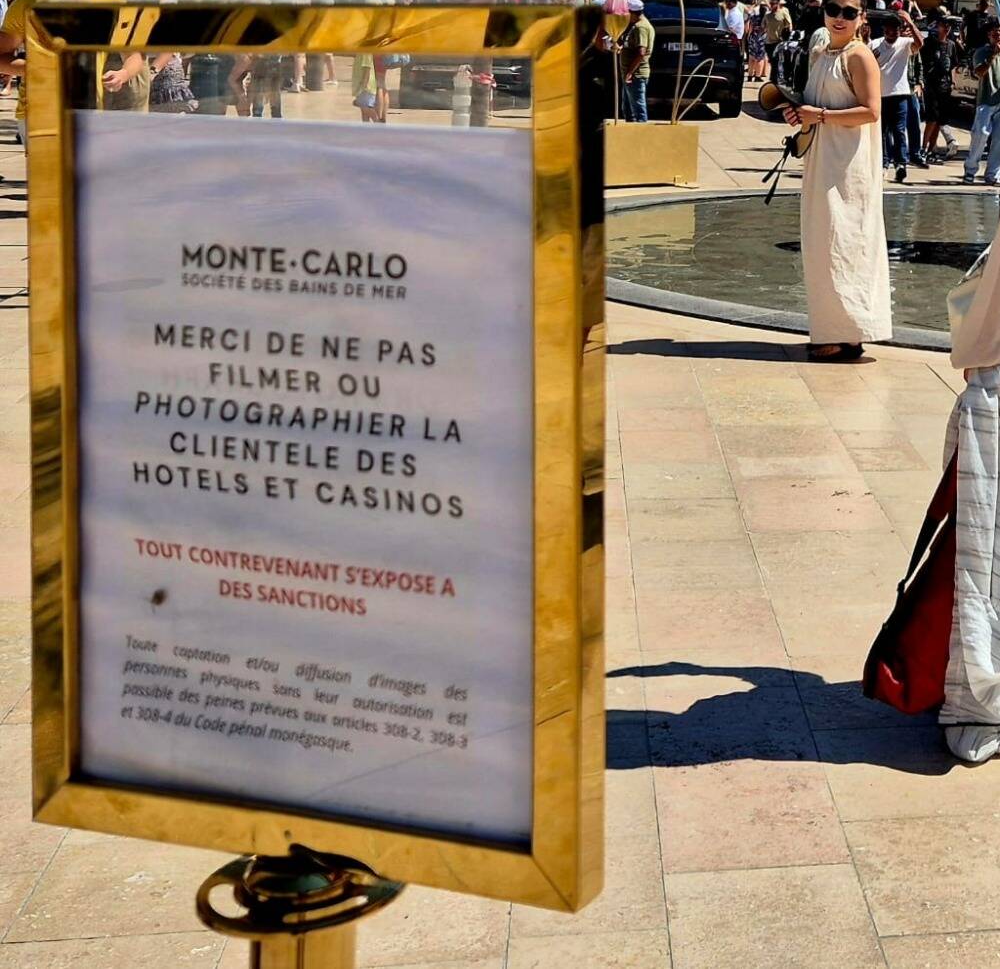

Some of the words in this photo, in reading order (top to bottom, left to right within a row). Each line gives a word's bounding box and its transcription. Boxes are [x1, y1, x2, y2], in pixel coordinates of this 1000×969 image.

[251, 277, 283, 292] DES
[289, 280, 338, 296] BAINS
[344, 283, 365, 297] DE
[372, 285, 408, 300] MER
[154, 323, 250, 353] MERCI
[267, 331, 305, 356] DE
[322, 336, 361, 361] NE
[378, 339, 437, 367] PAS
[209, 362, 321, 393] FILMER
[338, 373, 381, 398] OU
[134, 391, 406, 438] PHOTOGRAPHIER
[423, 417, 462, 443] LA
[169, 431, 340, 469] CLIENTELE
[356, 449, 417, 477] DES
[133, 462, 249, 496] HOTELS
[265, 476, 299, 499] ET
[316, 481, 464, 518] CASINOS
[135, 538, 184, 561] TOUT
[188, 546, 341, 582] CONTREVENANT
[345, 565, 436, 595] S'EXPOSE
[440, 578, 456, 597] A
[218, 579, 252, 600] DES
[257, 584, 368, 616] SANCTIONS
[125, 635, 158, 653] Toute
[173, 645, 231, 665] captation
[246, 656, 280, 674] et/ou
[295, 662, 352, 684] diffusion
[368, 672, 427, 698] d'images
[444, 684, 468, 702] des
[122, 659, 188, 680] personnes
[199, 670, 261, 692] physiques
[272, 683, 301, 699] sans
[313, 686, 340, 705] leur
[352, 696, 434, 721] autorisation
[447, 712, 468, 728] est
[178, 687, 200, 705] des
[203, 694, 246, 712] peines
[249, 699, 299, 720] prévues
[303, 709, 328, 724] aux
[331, 715, 379, 733] articles
[120, 705, 133, 720] et
[135, 706, 173, 724] 308-4
[173, 712, 193, 728] du
[194, 715, 227, 733] Code
[228, 722, 268, 738] pénal
[268, 728, 354, 755] monégasque.
